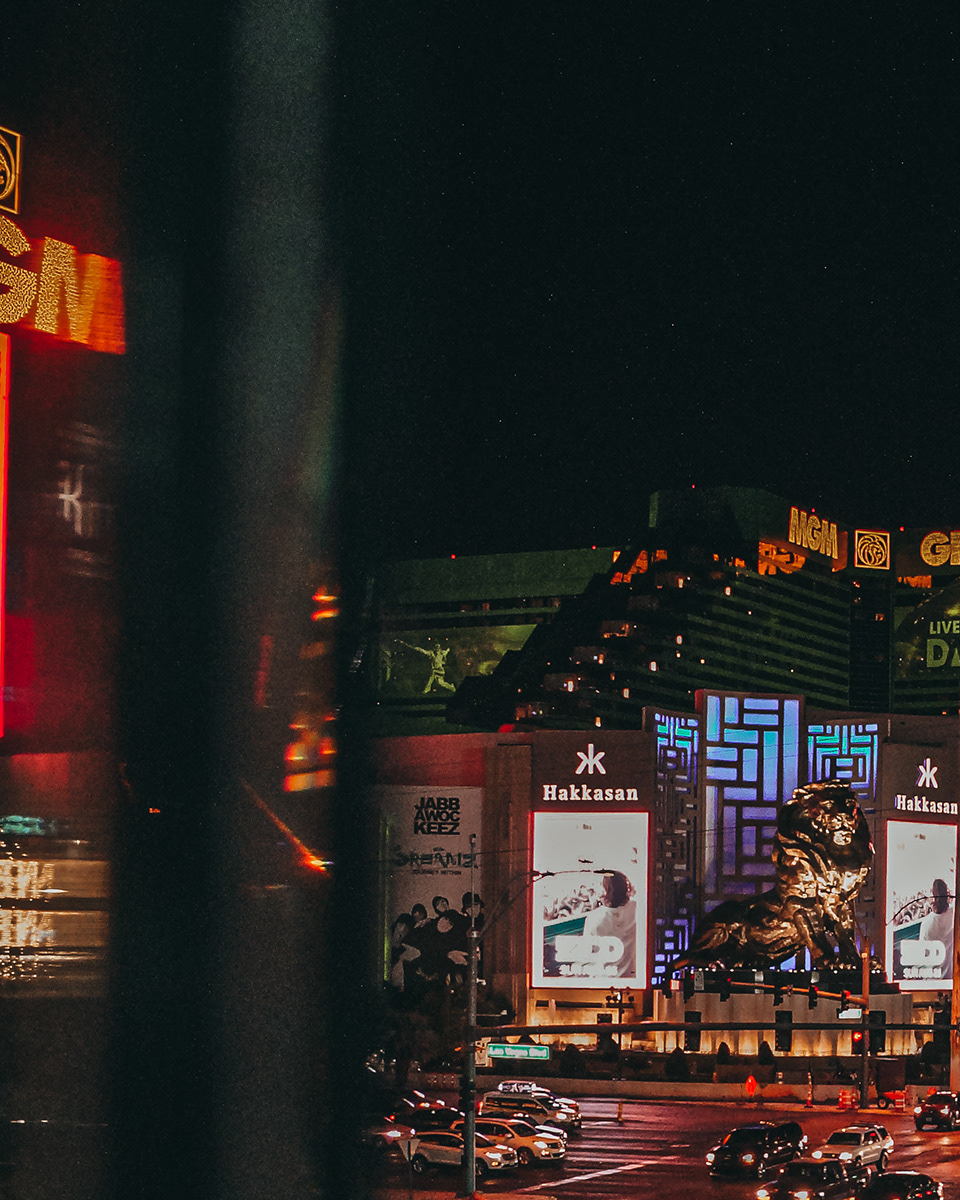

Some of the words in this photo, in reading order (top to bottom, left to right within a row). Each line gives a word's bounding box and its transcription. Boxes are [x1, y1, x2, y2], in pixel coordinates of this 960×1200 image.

[789, 506, 838, 559] MGM
[929, 621, 960, 635] LIVE
[543, 785, 639, 801] Hakkasan
[414, 797, 460, 810] JABB
[895, 794, 959, 815] Hakkasan
[414, 810, 460, 821] AWOC
[414, 822, 460, 835] KEEZ
